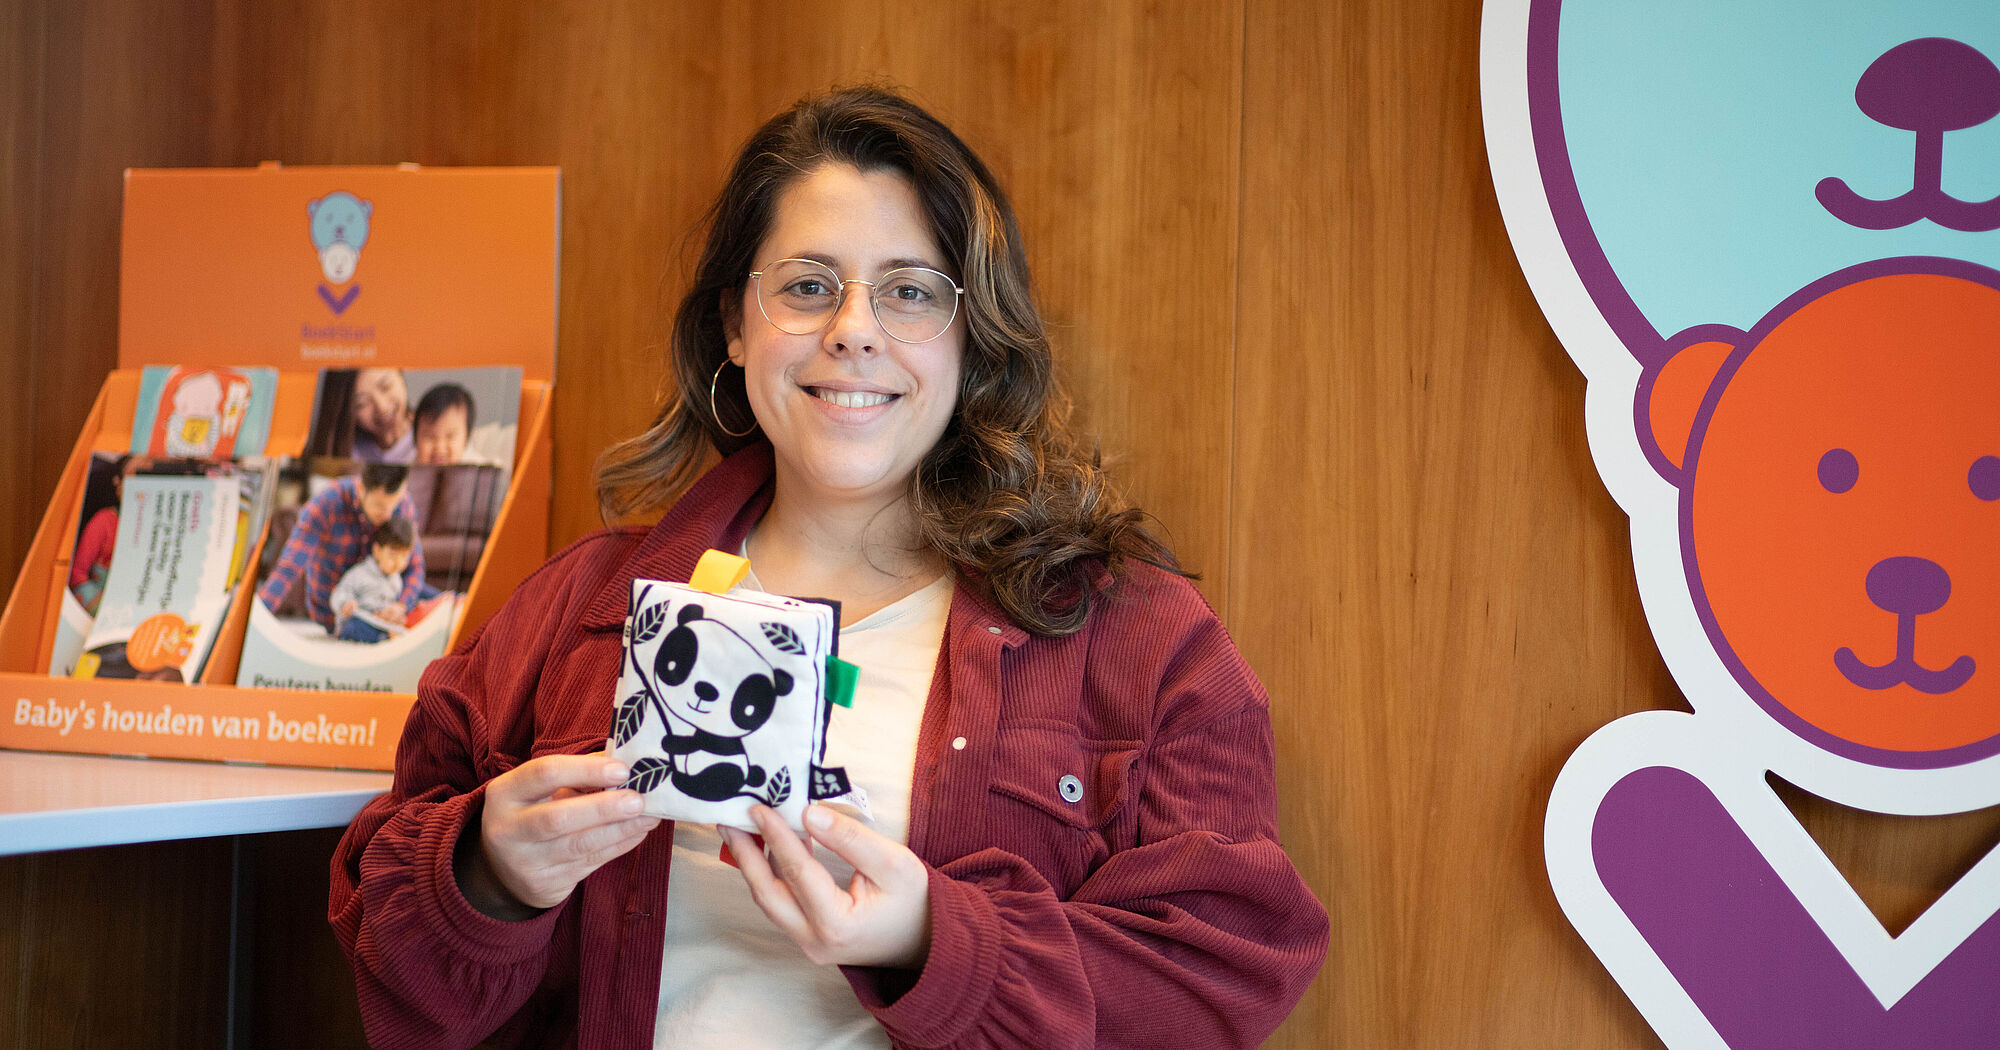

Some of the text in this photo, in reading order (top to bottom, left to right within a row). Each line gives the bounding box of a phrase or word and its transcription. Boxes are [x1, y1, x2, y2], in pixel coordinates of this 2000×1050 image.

[14, 698, 378, 746] Baby's houden van boeken!
